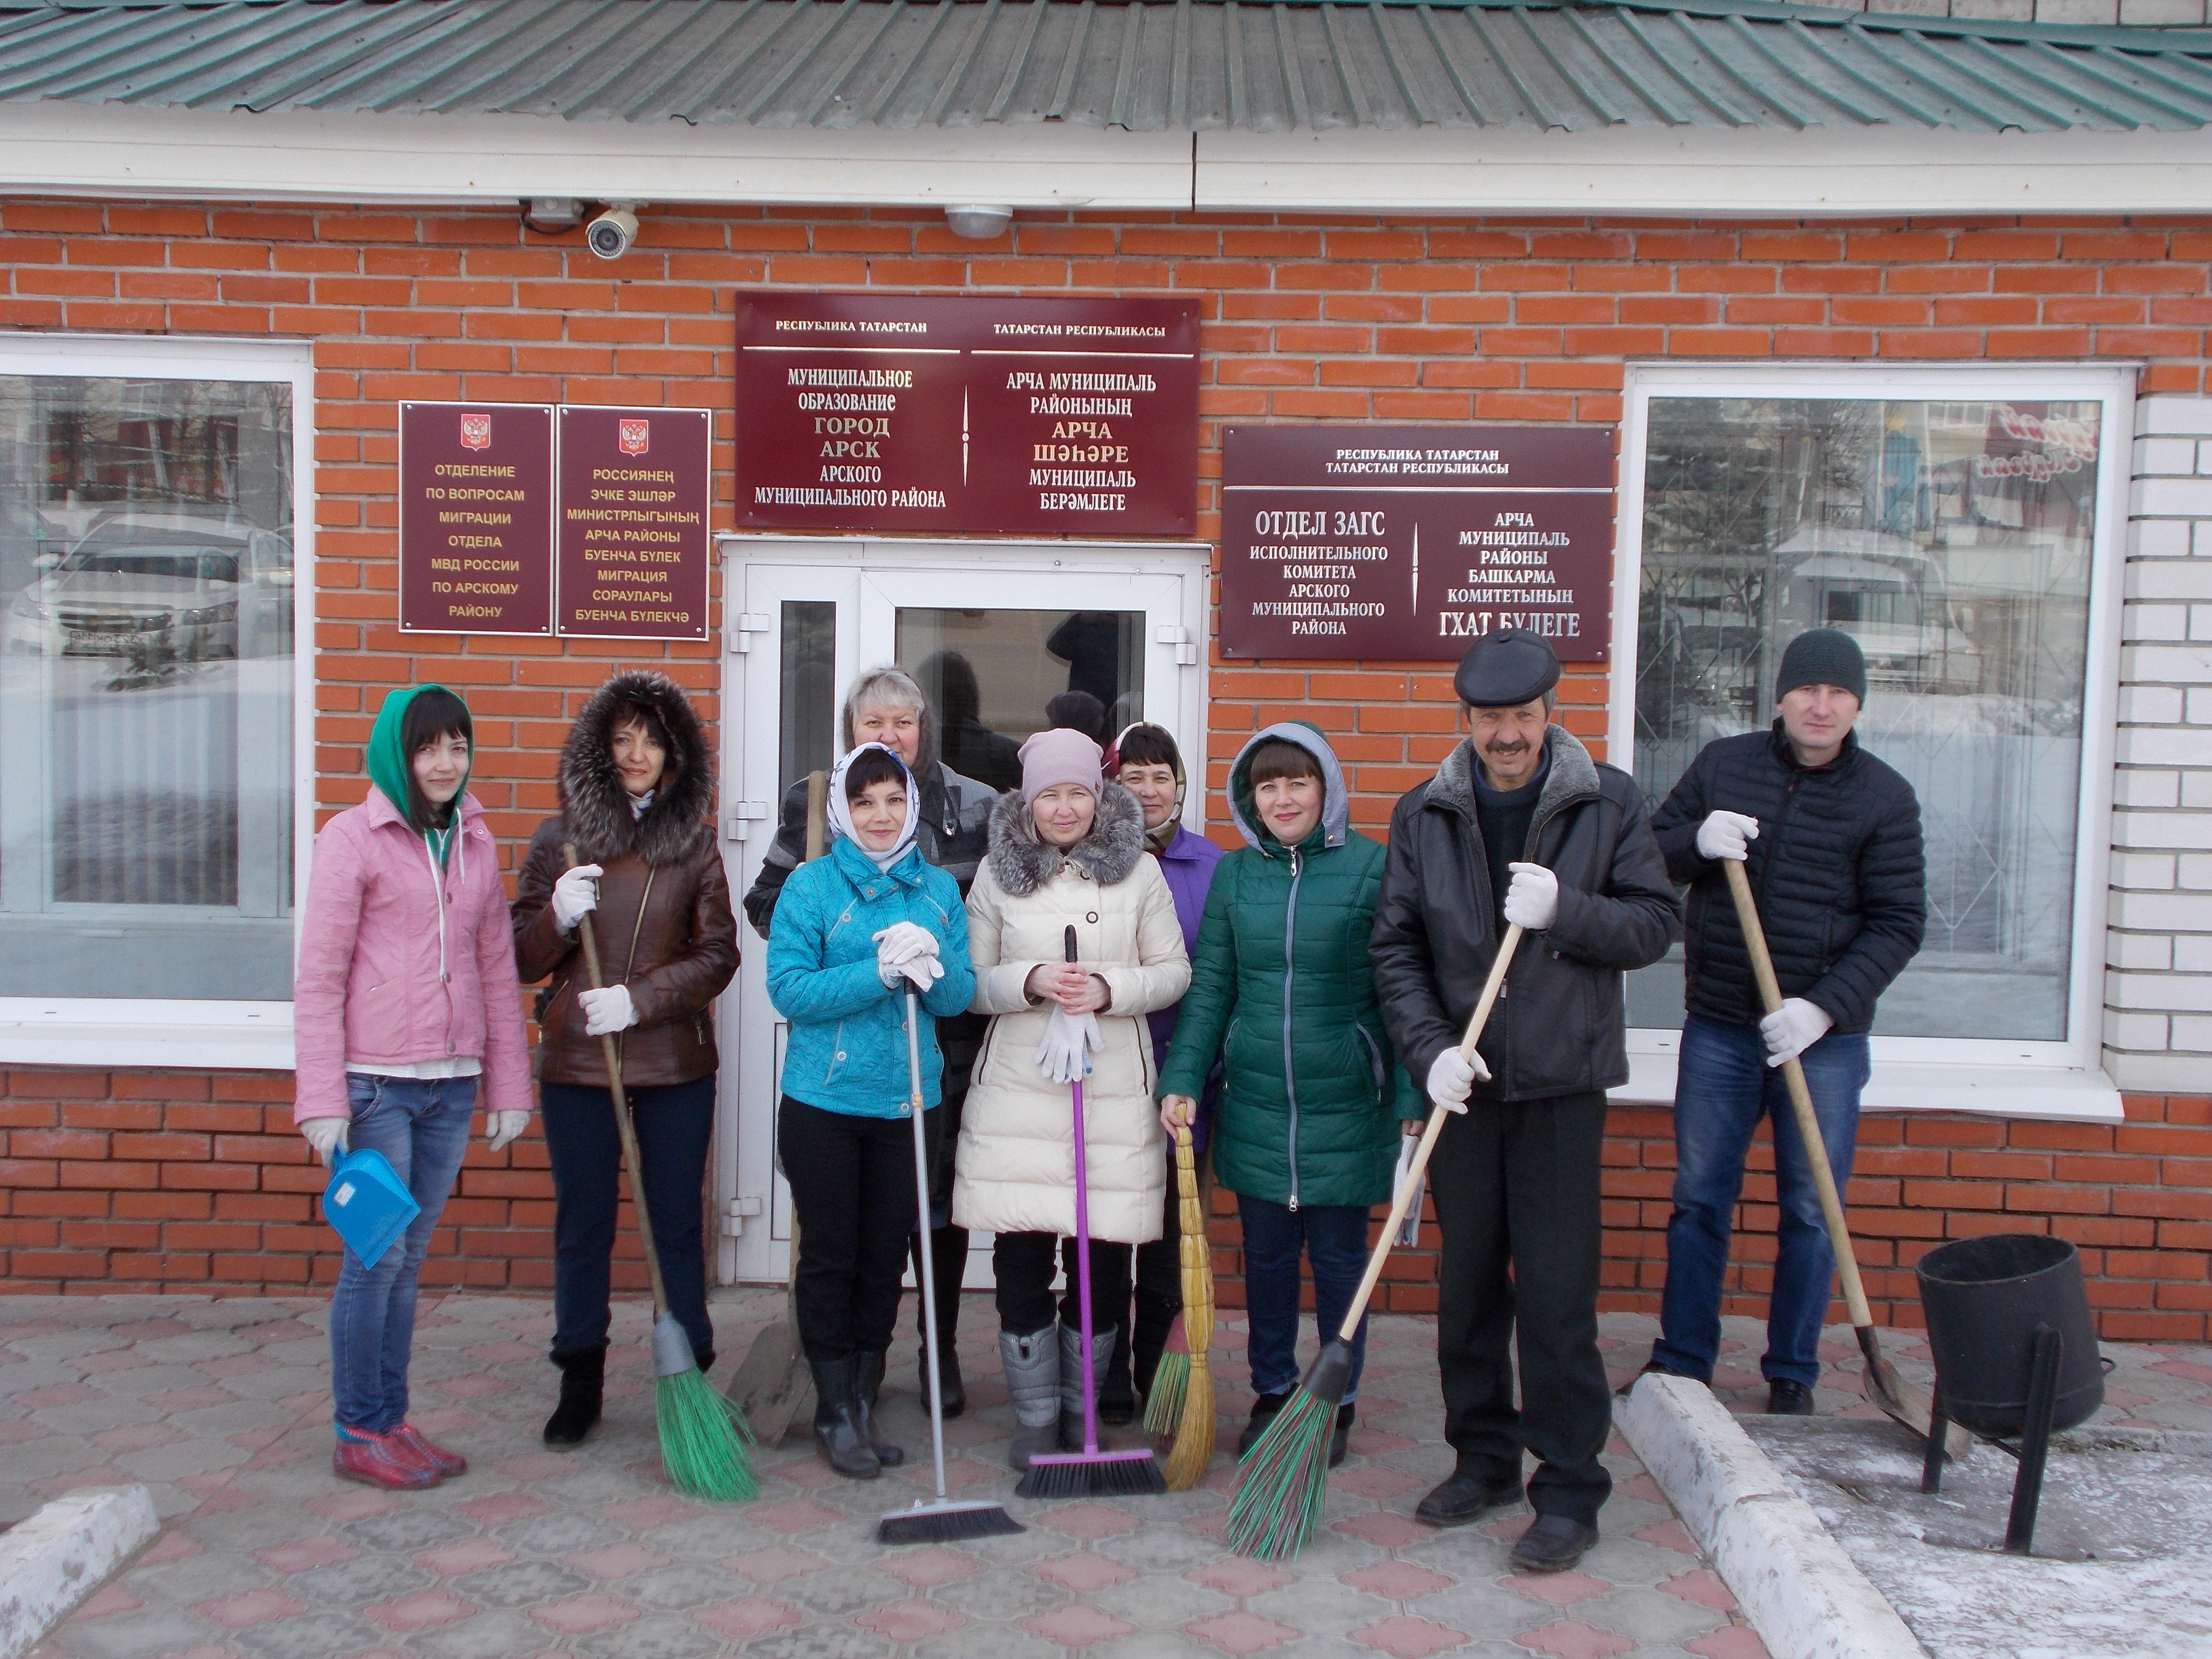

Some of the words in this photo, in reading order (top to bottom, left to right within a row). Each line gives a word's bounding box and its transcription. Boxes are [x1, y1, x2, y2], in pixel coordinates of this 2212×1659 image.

[776, 321, 856, 331] РЕСПУБЛИКА
[859, 322, 926, 333] ТАТАРСТАН
[994, 324, 1061, 335] ТАТАРСТАН
[1066, 325, 1165, 337] РЕСПУБЛИКАСЫ
[788, 368, 912, 389] МУНИЦИПАЛЬНОЕ
[1006, 372, 1045, 390] АРЧА
[1049, 373, 1156, 394] МУНИЦИПАЛЬ
[1031, 393, 1132, 417] РАЙОНЫНЫҢ
[815, 417, 890, 438] ГОРОД
[1052, 421, 1113, 439] АРЧА
[820, 441, 880, 458] АРСК
[1336, 449, 1422, 460] РЕСПУБЛИКА
[1426, 450, 1499, 461] ТАТАРСТАН
[435, 465, 515, 477] ОТДЕЛЕНИЕ
[819, 465, 881, 482] АРСКОГО
[1326, 463, 1398, 473] ТАТАРСТАН
[1403, 463, 1509, 474] РЕСПУБЛИКАСЫ
[594, 469, 674, 483] РОССИЯНЕҢ
[1029, 469, 1136, 489] МУНИЦИПАЛЬ
[426, 488, 445, 499] ПО
[449, 489, 524, 501] ВОПРОСАМ
[591, 489, 624, 501] ЭЧКЕ
[628, 490, 675, 502] ЭШЛӘР
[755, 487, 887, 507] МУНИЦИПАЛЬНОГО
[891, 486, 946, 507] РАЙОНА
[1040, 493, 1125, 511] БЕРӘМЛЕГЕ
[440, 512, 511, 526] МИГРАЦИИ
[567, 509, 699, 524] МИНИСТРЛЫГЫНЫҢ
[1494, 513, 1534, 527] АРЧА
[1256, 511, 1326, 540] ОТДЕЛ
[1334, 511, 1384, 536] ЗАГС
[449, 536, 502, 548] ОТДЕЛА
[585, 529, 621, 541] АРЧА
[625, 529, 680, 542] РАЙОНЫ
[1459, 531, 1570, 547] МУНИЦИПАЛЬ
[585, 550, 637, 561] БУЕНЧА
[640, 551, 681, 562] БҮЛЕК
[1250, 546, 1388, 560] ИСПОЛНИТЕЛЬНОГО
[1480, 548, 1548, 565] РАЙОНЫ
[432, 558, 460, 571] МВД
[464, 559, 519, 571] РОССИИ
[1284, 565, 1356, 578] КОМИТЕТА
[598, 570, 667, 583] МИГРАЦИЯ
[1468, 569, 1556, 584] БАШКАРМА
[433, 582, 451, 592] ПО
[455, 583, 518, 594] АРСКОМУ
[1289, 584, 1349, 598] АРСКОГО
[593, 590, 672, 602] СОРАУЛАРЫ
[449, 604, 502, 617] РАЙОНУ
[576, 609, 627, 621] БУЕНЧА
[1252, 602, 1384, 618] МУНИЦИПАЛЬНОГО
[1292, 618, 1346, 635] РАЙОНА
[1439, 612, 1492, 637] ГХАТ
